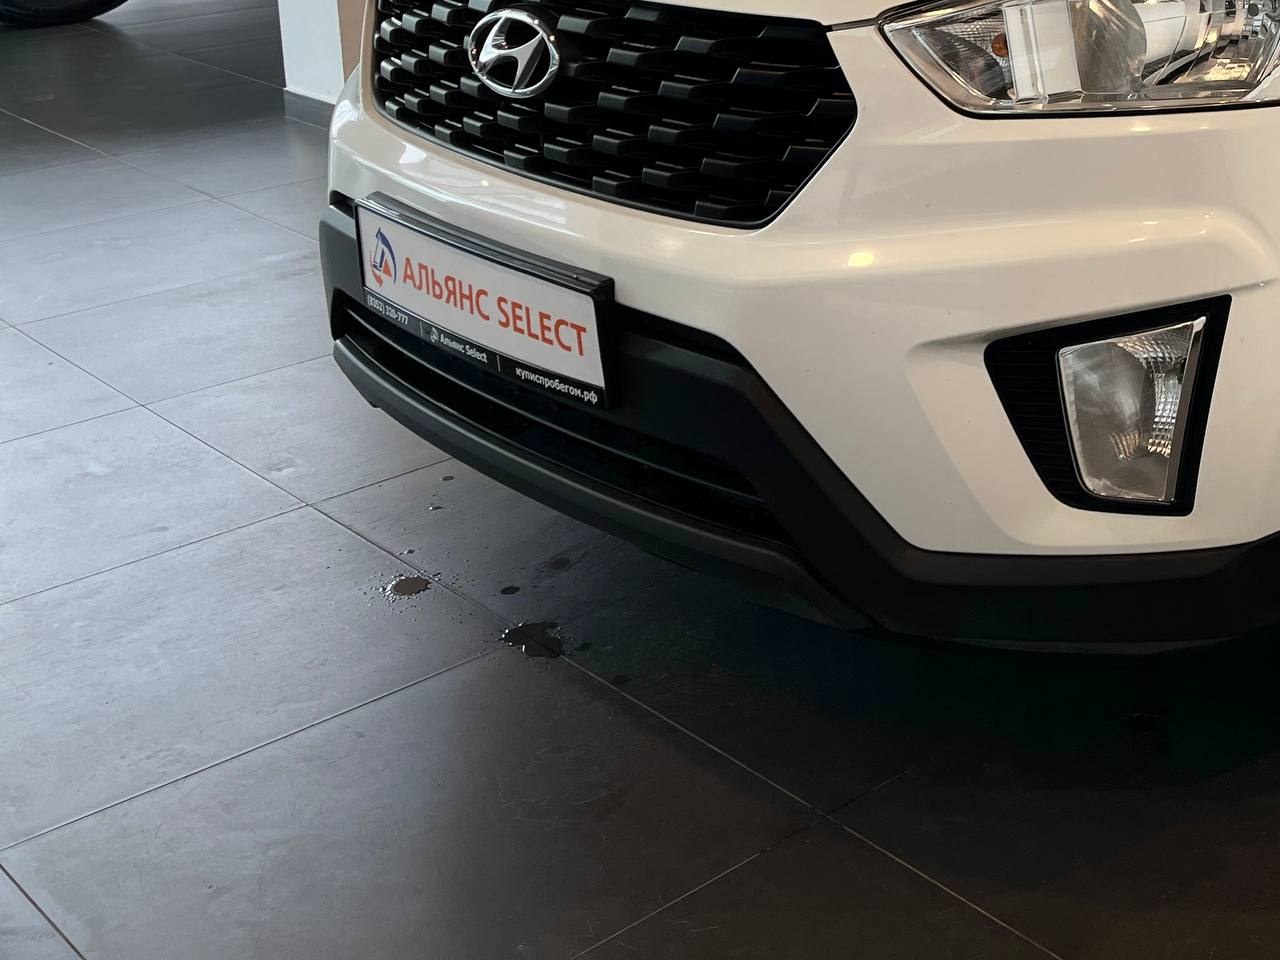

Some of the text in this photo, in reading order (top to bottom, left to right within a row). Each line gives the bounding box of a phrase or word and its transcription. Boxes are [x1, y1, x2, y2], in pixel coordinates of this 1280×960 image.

[402, 256, 587, 357] АЛЬЯНС SELECT
[465, 344, 488, 363] Select
[515, 367, 598, 404] куписпробегом.рф
